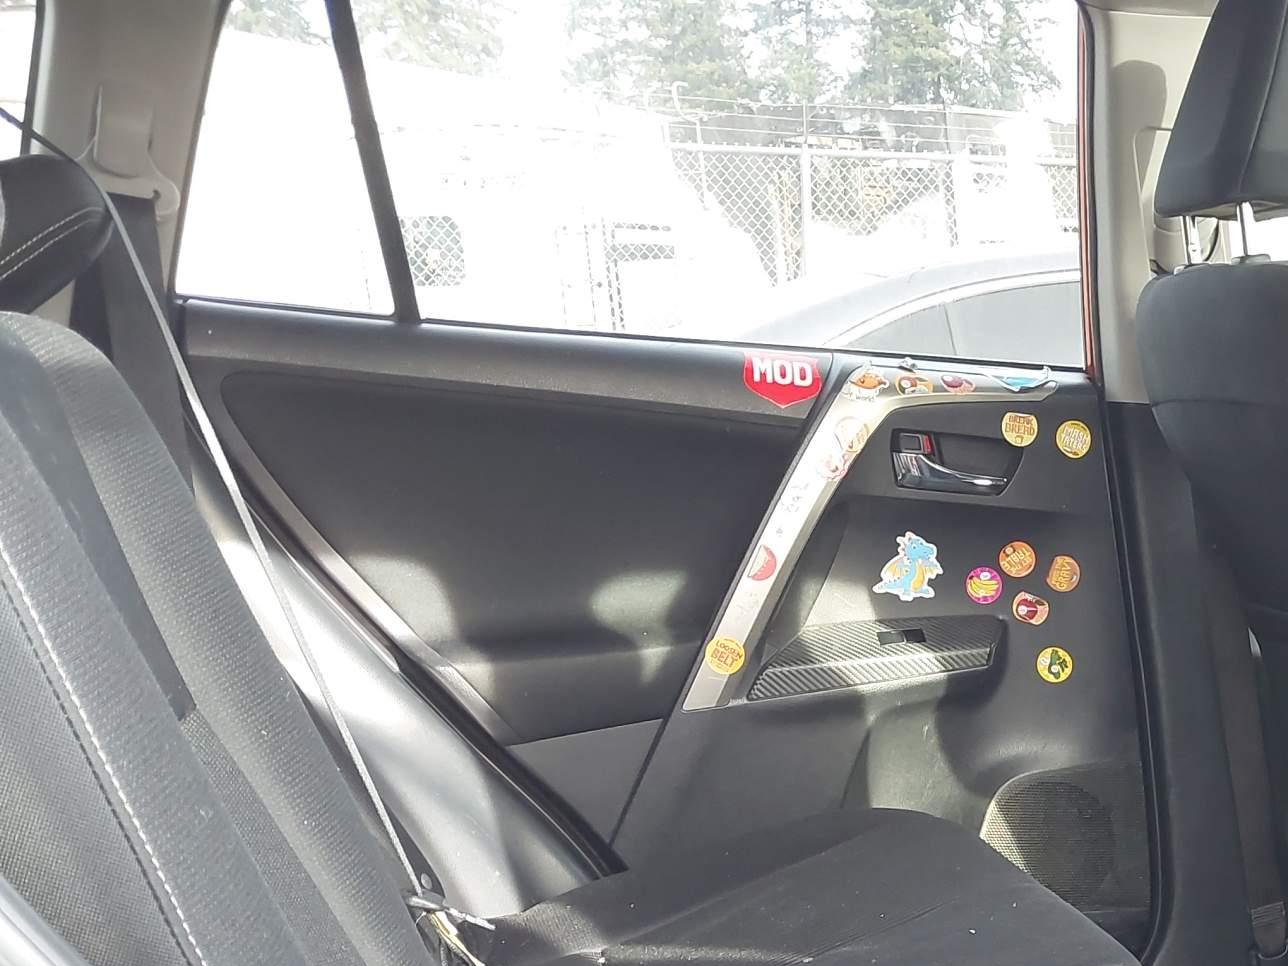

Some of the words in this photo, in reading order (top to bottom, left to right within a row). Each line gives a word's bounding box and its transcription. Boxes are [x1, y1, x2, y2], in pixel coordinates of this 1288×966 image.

[751, 357, 813, 387] MOD
[1005, 422, 1035, 435] BREAD
[711, 648, 738, 667] BELT
